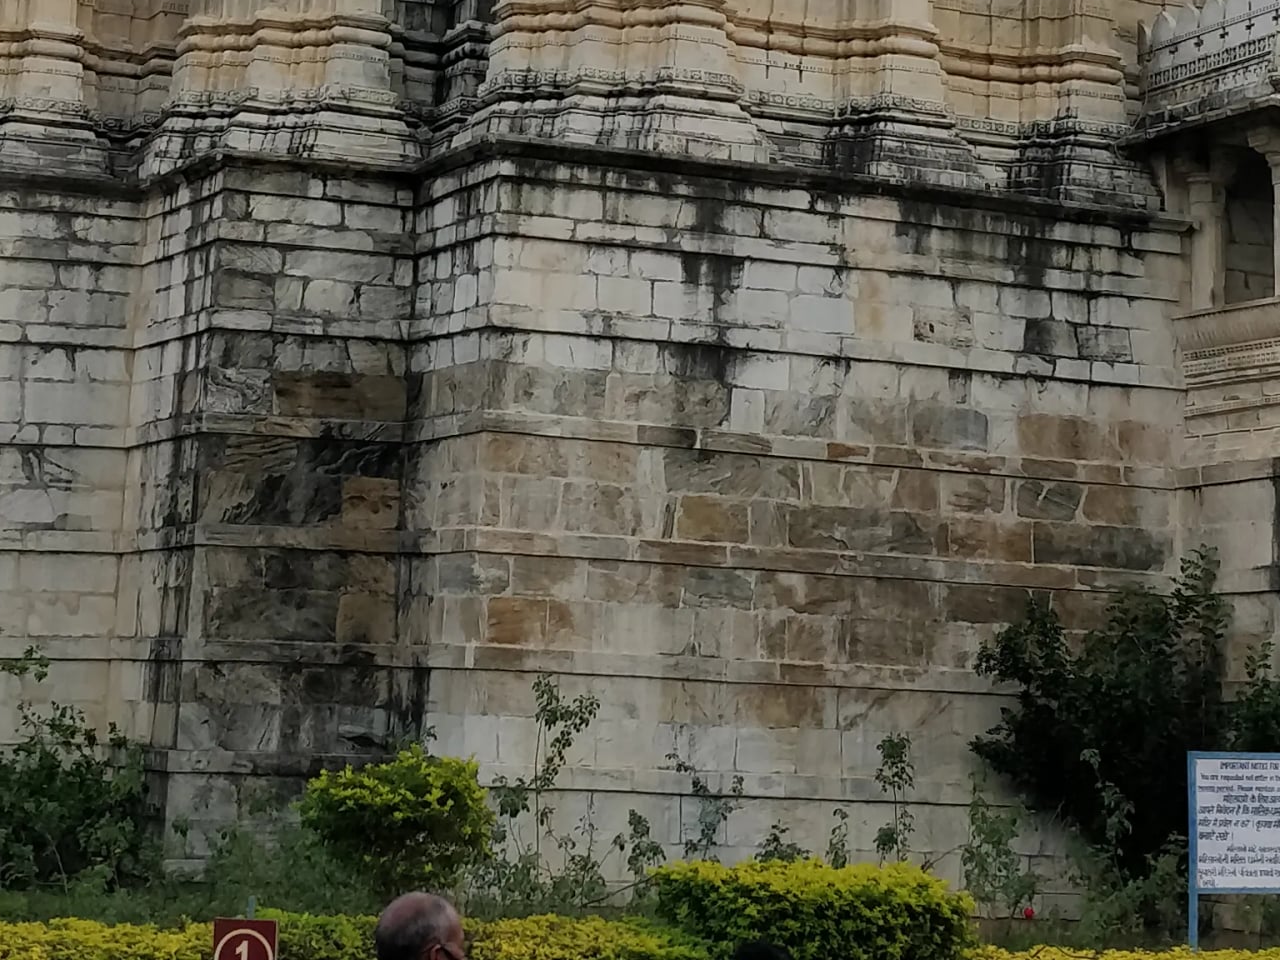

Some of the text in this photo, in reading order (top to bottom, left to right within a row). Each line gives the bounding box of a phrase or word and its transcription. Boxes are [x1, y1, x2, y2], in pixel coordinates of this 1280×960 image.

[1220, 761, 1249, 770] IMPORTANT
[1251, 762, 1268, 770] NOTICE
[1269, 762, 1280, 771] FOR
[235, 940, 249, 960] 1
